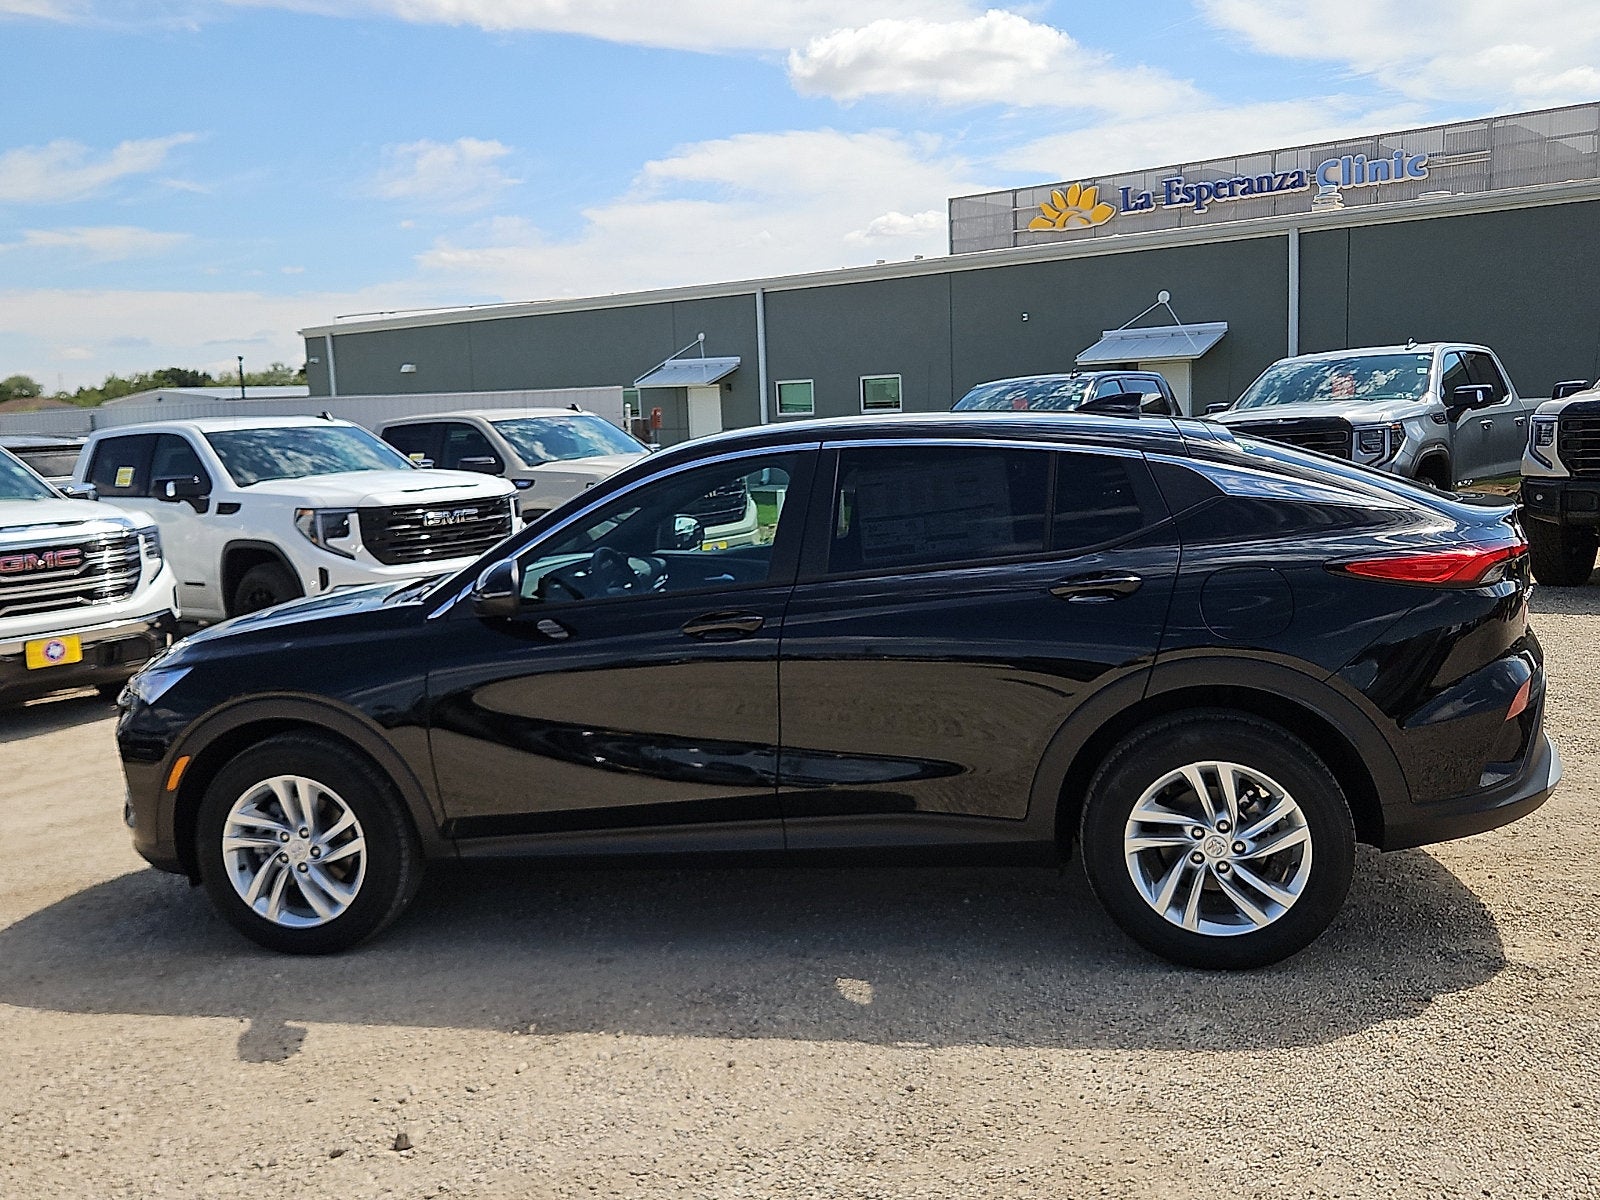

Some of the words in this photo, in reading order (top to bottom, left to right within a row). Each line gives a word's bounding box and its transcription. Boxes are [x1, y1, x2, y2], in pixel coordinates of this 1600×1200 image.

[1119, 186, 1154, 215] La
[1162, 168, 1309, 213] Esperanza
[1316, 150, 1429, 190] Clinic
[423, 508, 479, 527] GMC
[0, 548, 82, 573] GMC
